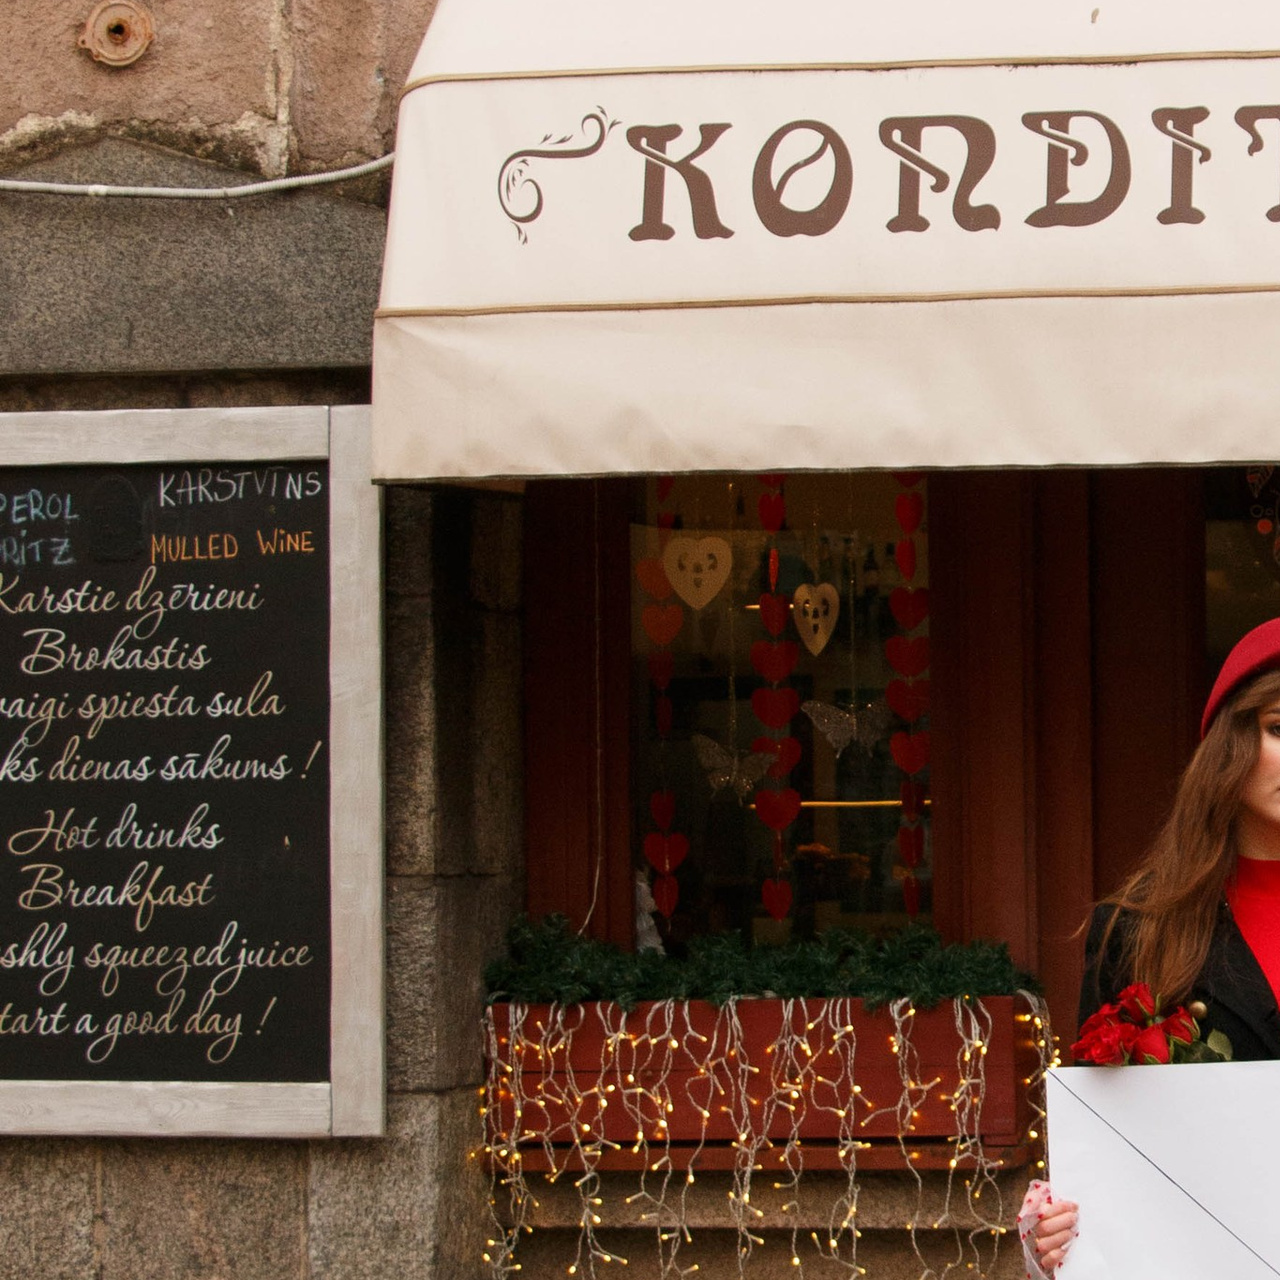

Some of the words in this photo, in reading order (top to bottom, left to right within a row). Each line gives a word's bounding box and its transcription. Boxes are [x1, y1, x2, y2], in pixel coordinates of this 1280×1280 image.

[151, 532, 239, 564] MULLED
[125, 565, 265, 640] dzērieni
[20, 625, 212, 675] Brokastis
[78, 685, 201, 739] spiesta
[206, 671, 286, 717] sula
[49, 735, 155, 782] dienas
[8, 807, 101, 856] Hot
[105, 803, 225, 849] drinks
[19, 861, 217, 932] Breakfast
[85, 921, 238, 996] squeezed
[210, 938, 314, 996] juice
[75, 1013, 100, 1034] a
[87, 988, 185, 1063] good
